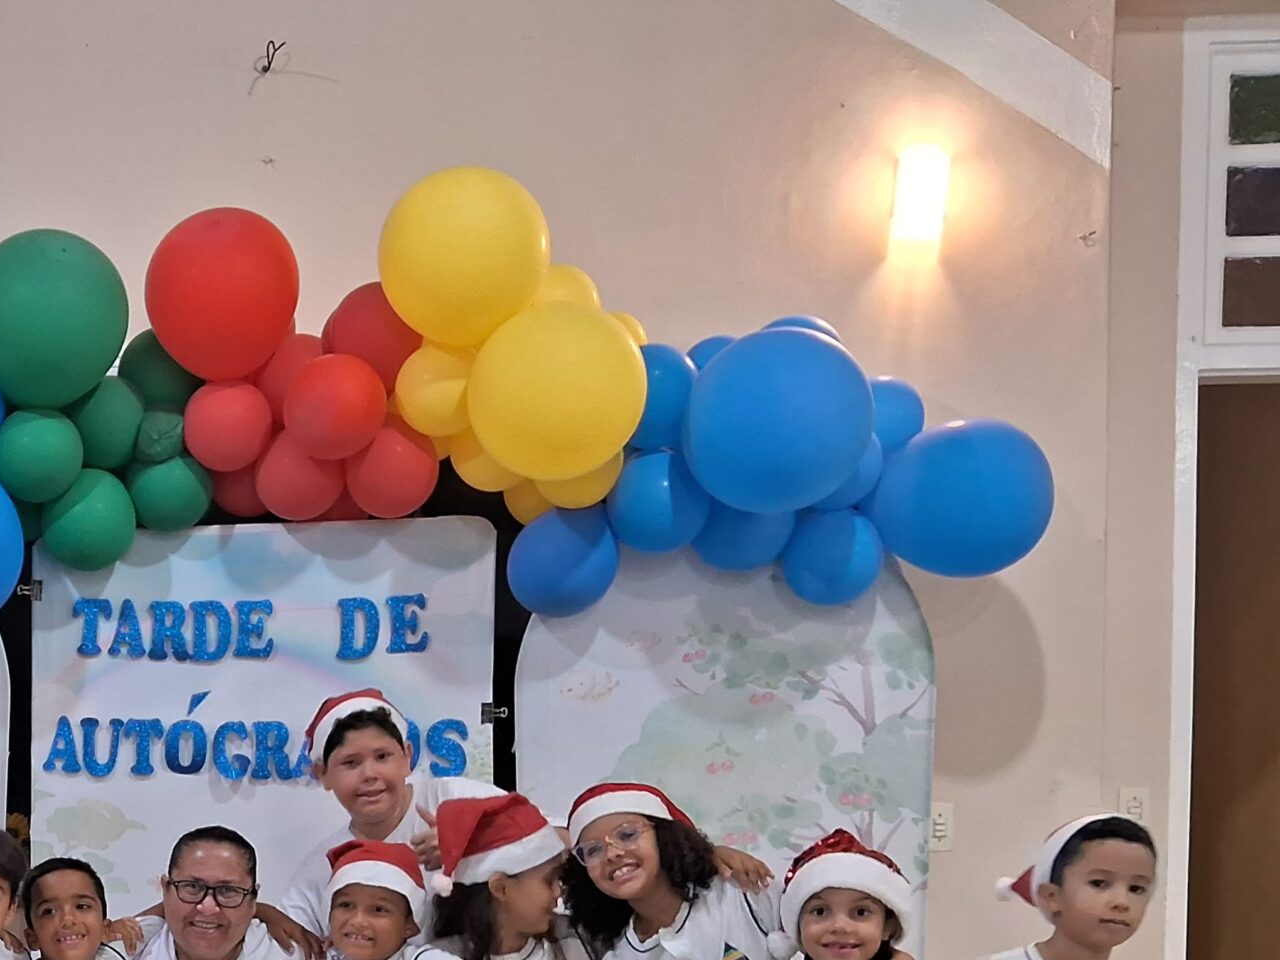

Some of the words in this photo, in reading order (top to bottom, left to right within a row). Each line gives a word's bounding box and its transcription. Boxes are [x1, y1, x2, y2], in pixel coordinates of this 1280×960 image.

[72, 597, 274, 662] TARDE
[336, 593, 430, 661] DE
[42, 690, 468, 781] AUTÓGRS
